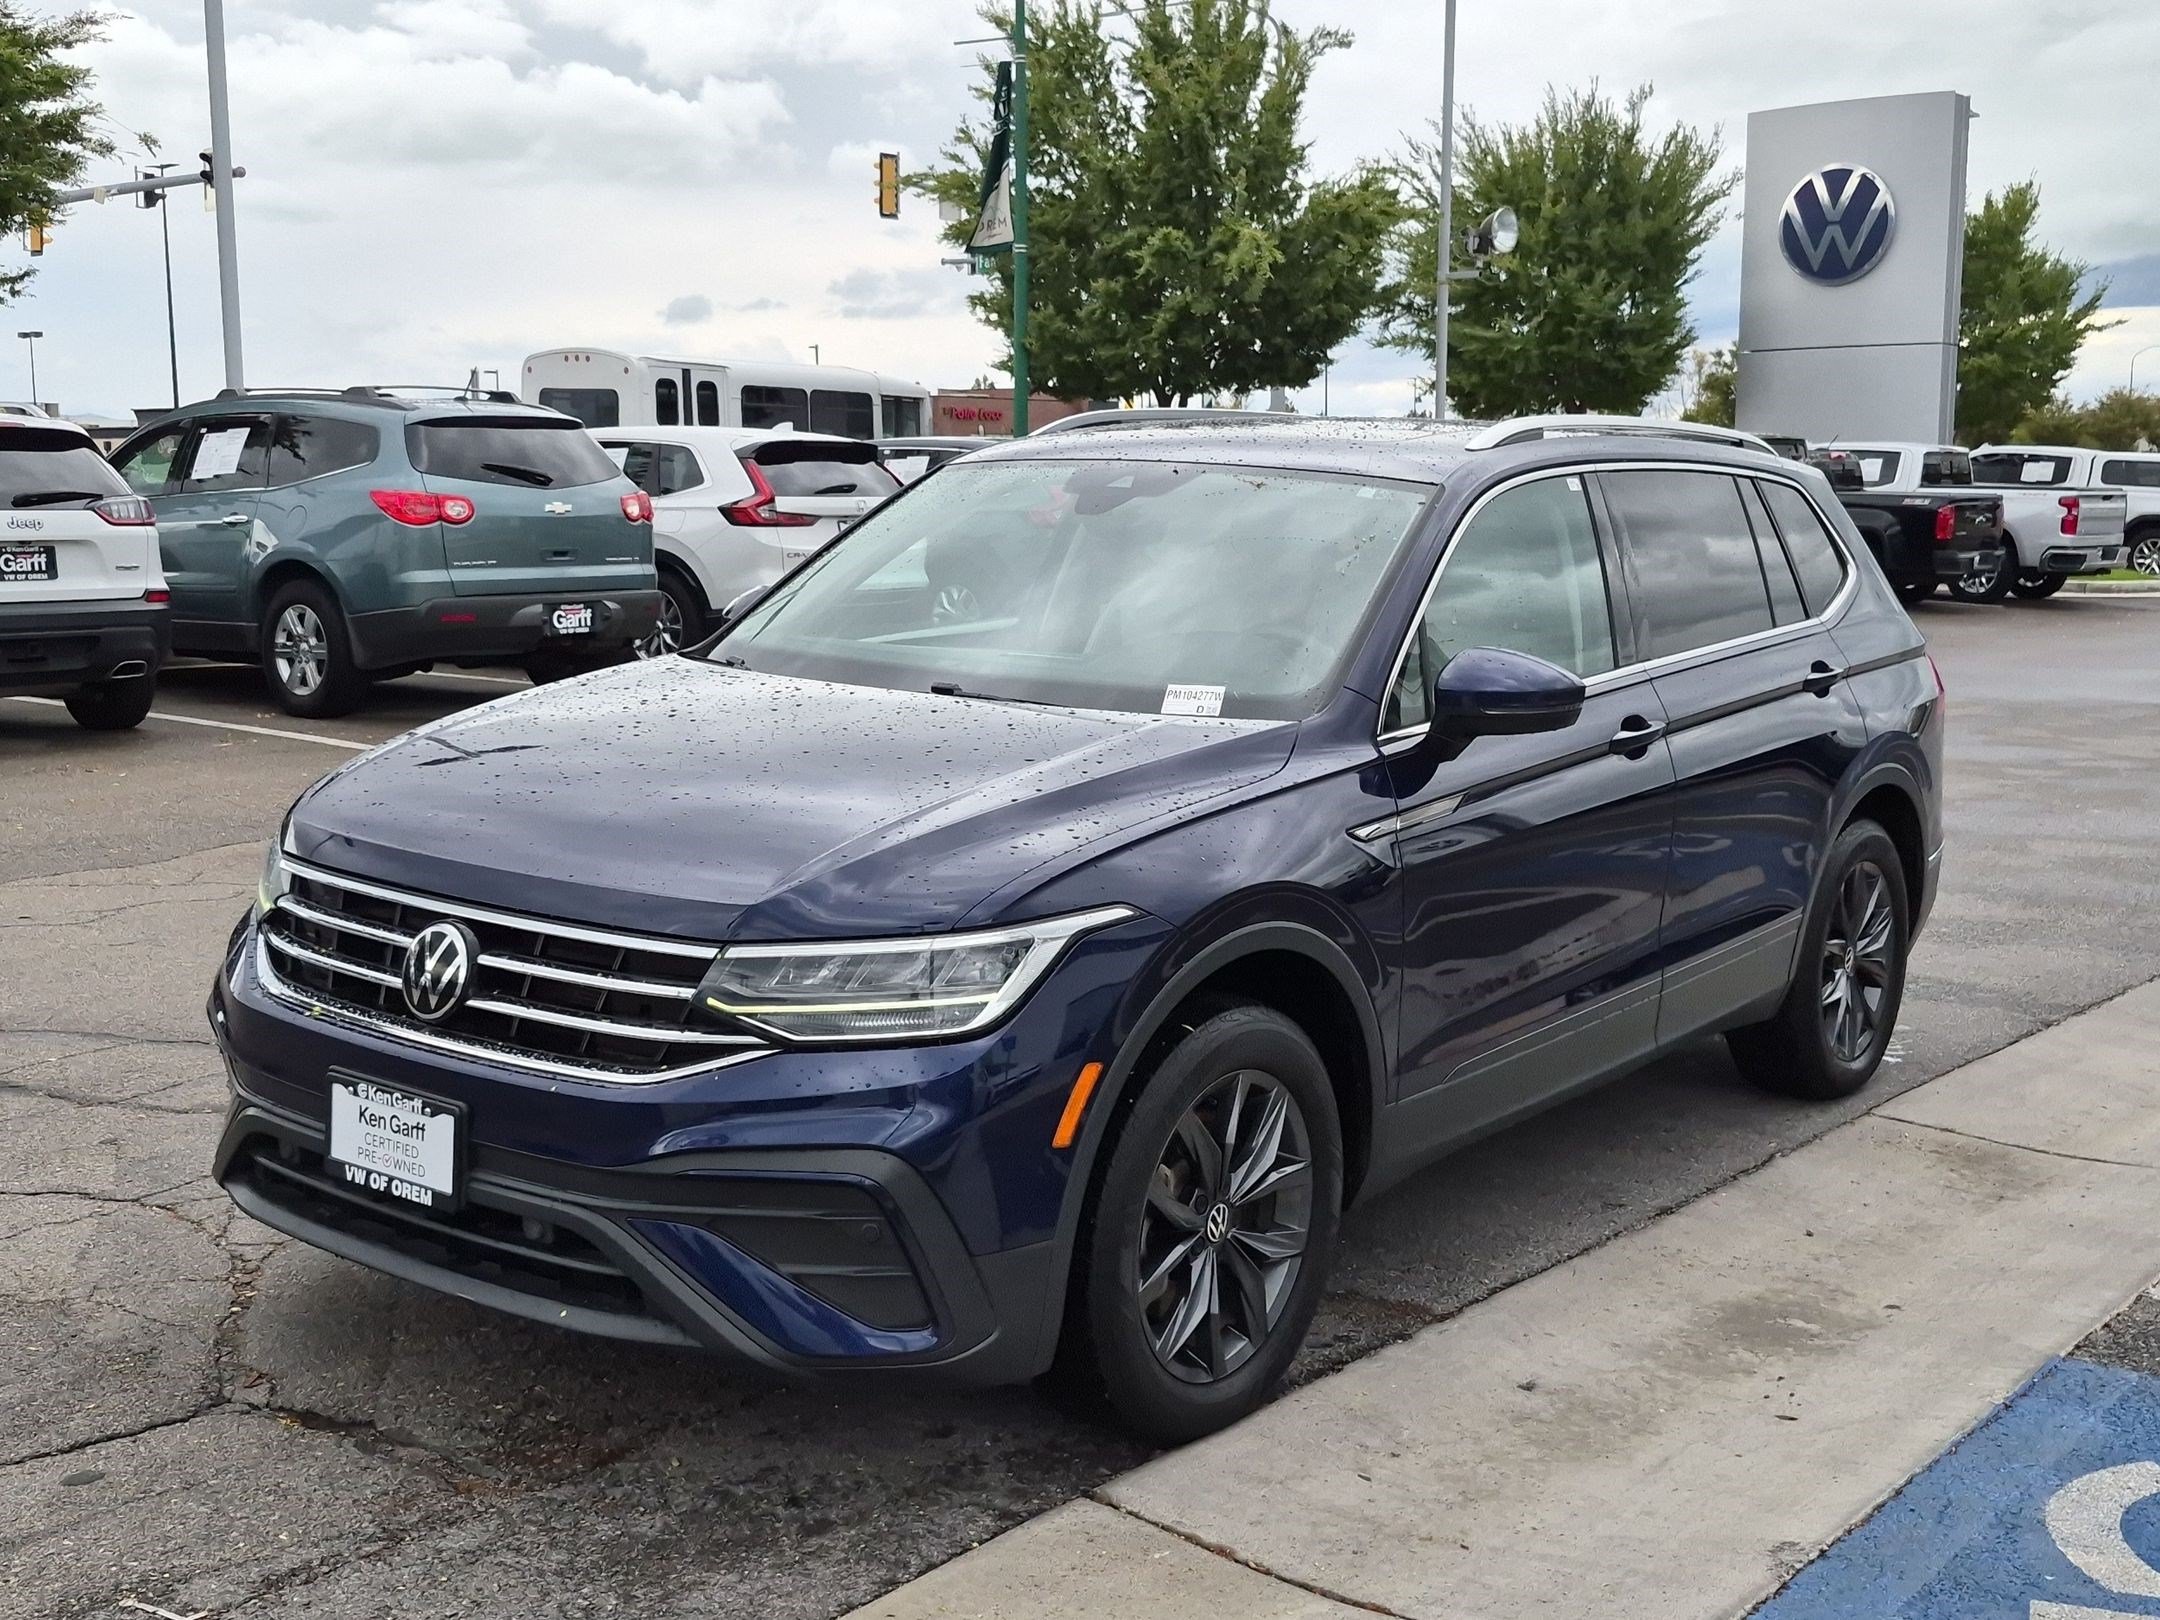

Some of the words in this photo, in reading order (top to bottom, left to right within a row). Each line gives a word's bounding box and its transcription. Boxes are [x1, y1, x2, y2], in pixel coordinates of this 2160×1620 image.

[7, 516, 44, 531] Jeep
[0, 553, 47, 573] Garff
[552, 608, 593, 629] Garff
[359, 1104, 387, 1131] Ken
[389, 1114, 426, 1142] Garff
[364, 1132, 420, 1159] CERTIFIED
[344, 1164, 367, 1186] VW
[369, 1172, 389, 1192] OF
[391, 1179, 433, 1207] OREM
